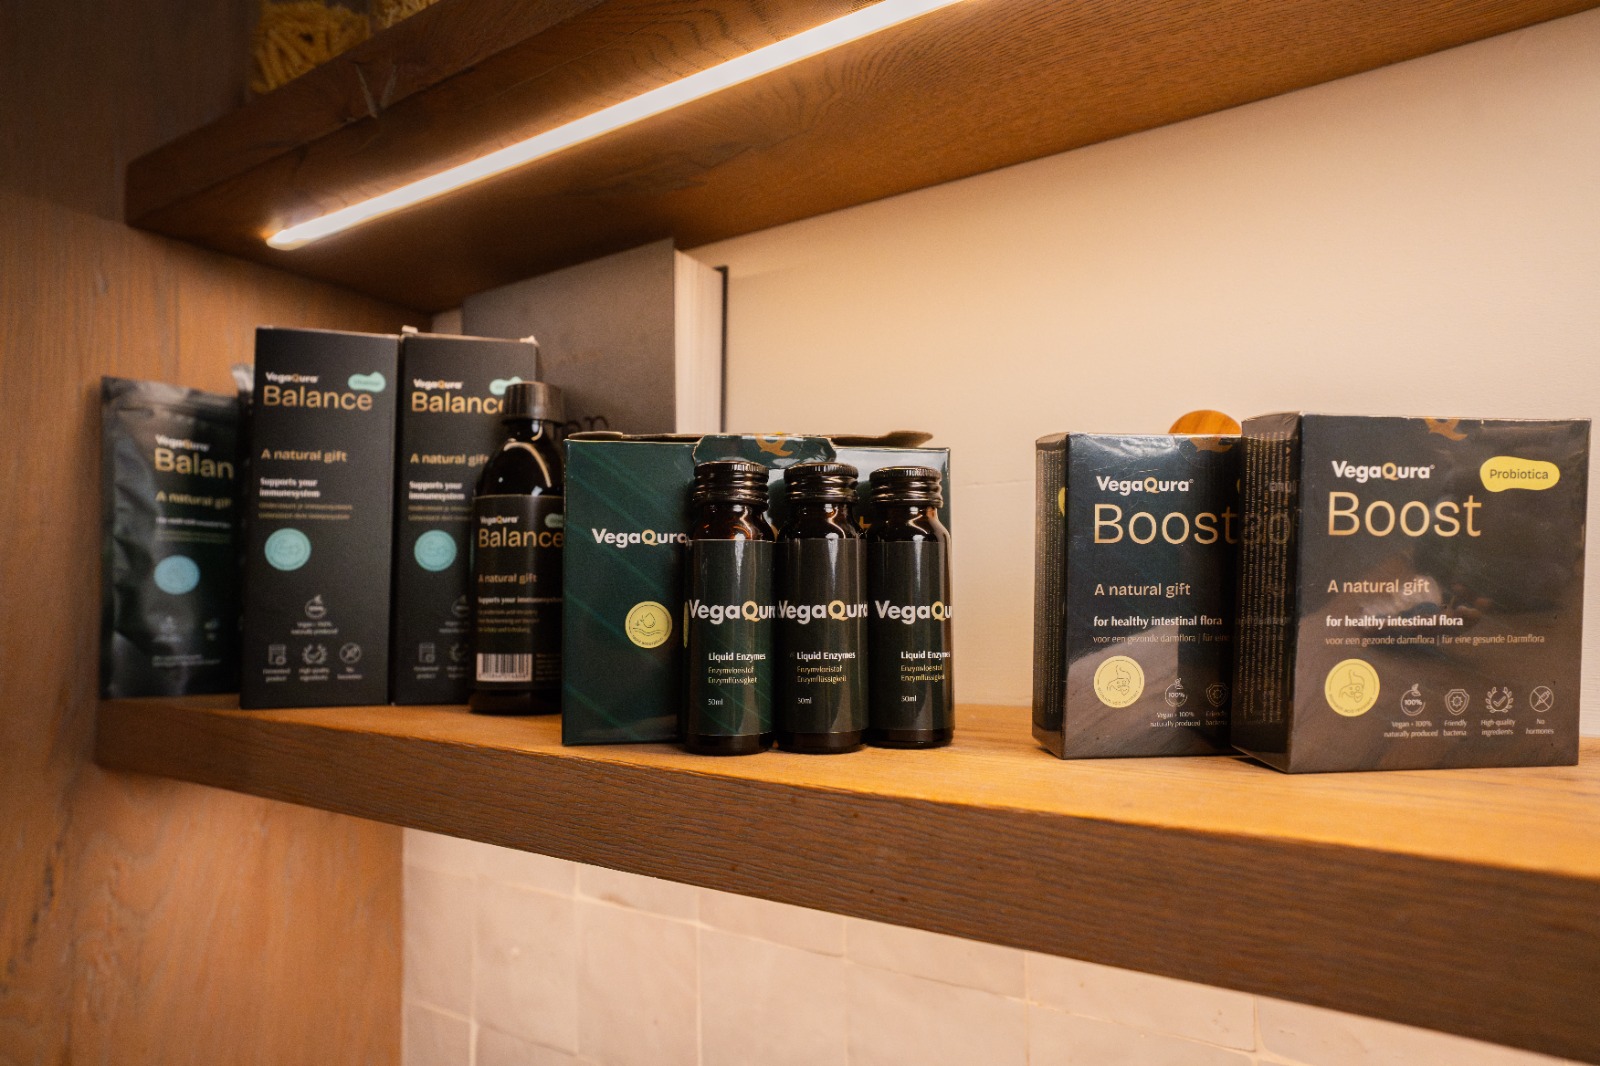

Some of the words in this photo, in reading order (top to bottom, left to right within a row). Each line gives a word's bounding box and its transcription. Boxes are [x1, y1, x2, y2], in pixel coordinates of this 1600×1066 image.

[263, 385, 373, 411] Balance
[261, 448, 271, 459] A
[274, 450, 321, 461] natural
[324, 450, 348, 464] gift
[410, 453, 420, 464] A
[422, 454, 466, 465] natural
[155, 447, 234, 479] Balan
[1489, 468, 1549, 480] Probiotica
[1328, 491, 1482, 537] Boost
[1094, 503, 1239, 545] Boost
[479, 527, 563, 547] Balance
[1094, 583, 1105, 596] A
[1108, 583, 1162, 596] natural
[1165, 582, 1191, 598] gift
[1328, 580, 1339, 593] A
[1343, 579, 1399, 593] natural
[1403, 579, 1430, 596] gift
[689, 599, 776, 625] VegaQur
[874, 600, 953, 625] VegaQu
[1093, 616, 1109, 627] for
[1111, 616, 1149, 629] healthy
[1151, 616, 1198, 626] intestinal
[1200, 615, 1223, 626] flora
[1326, 615, 1342, 627] for
[1344, 615, 1385, 630] healthy
[1387, 615, 1436, 626] intestinal
[1439, 615, 1463, 626] flora
[1128, 635, 1159, 645] gezonde
[1160, 633, 1196, 643] darmflora
[1326, 637, 1343, 645] voor
[1345, 637, 1359, 645] een
[1361, 635, 1394, 647] gezonde
[1396, 635, 1434, 645] darmflora
[1442, 635, 1452, 644] für
[1455, 635, 1471, 644] eine
[1472, 634, 1505, 646] gesunde
[1507, 634, 1545, 643] Darmflora
[708, 652, 734, 663] Liquid
[736, 652, 766, 663] Enzymes
[796, 651, 821, 662] Liquid
[823, 651, 856, 662] Enzymes
[900, 650, 926, 661] Liquid
[797, 696, 812, 705] 50ml
[901, 695, 917, 703] 50ml
[1391, 721, 1410, 729] Vegan
[1444, 719, 1467, 727] Friendly
[1411, 730, 1438, 738] produced
[1525, 727, 1554, 735] hormones
